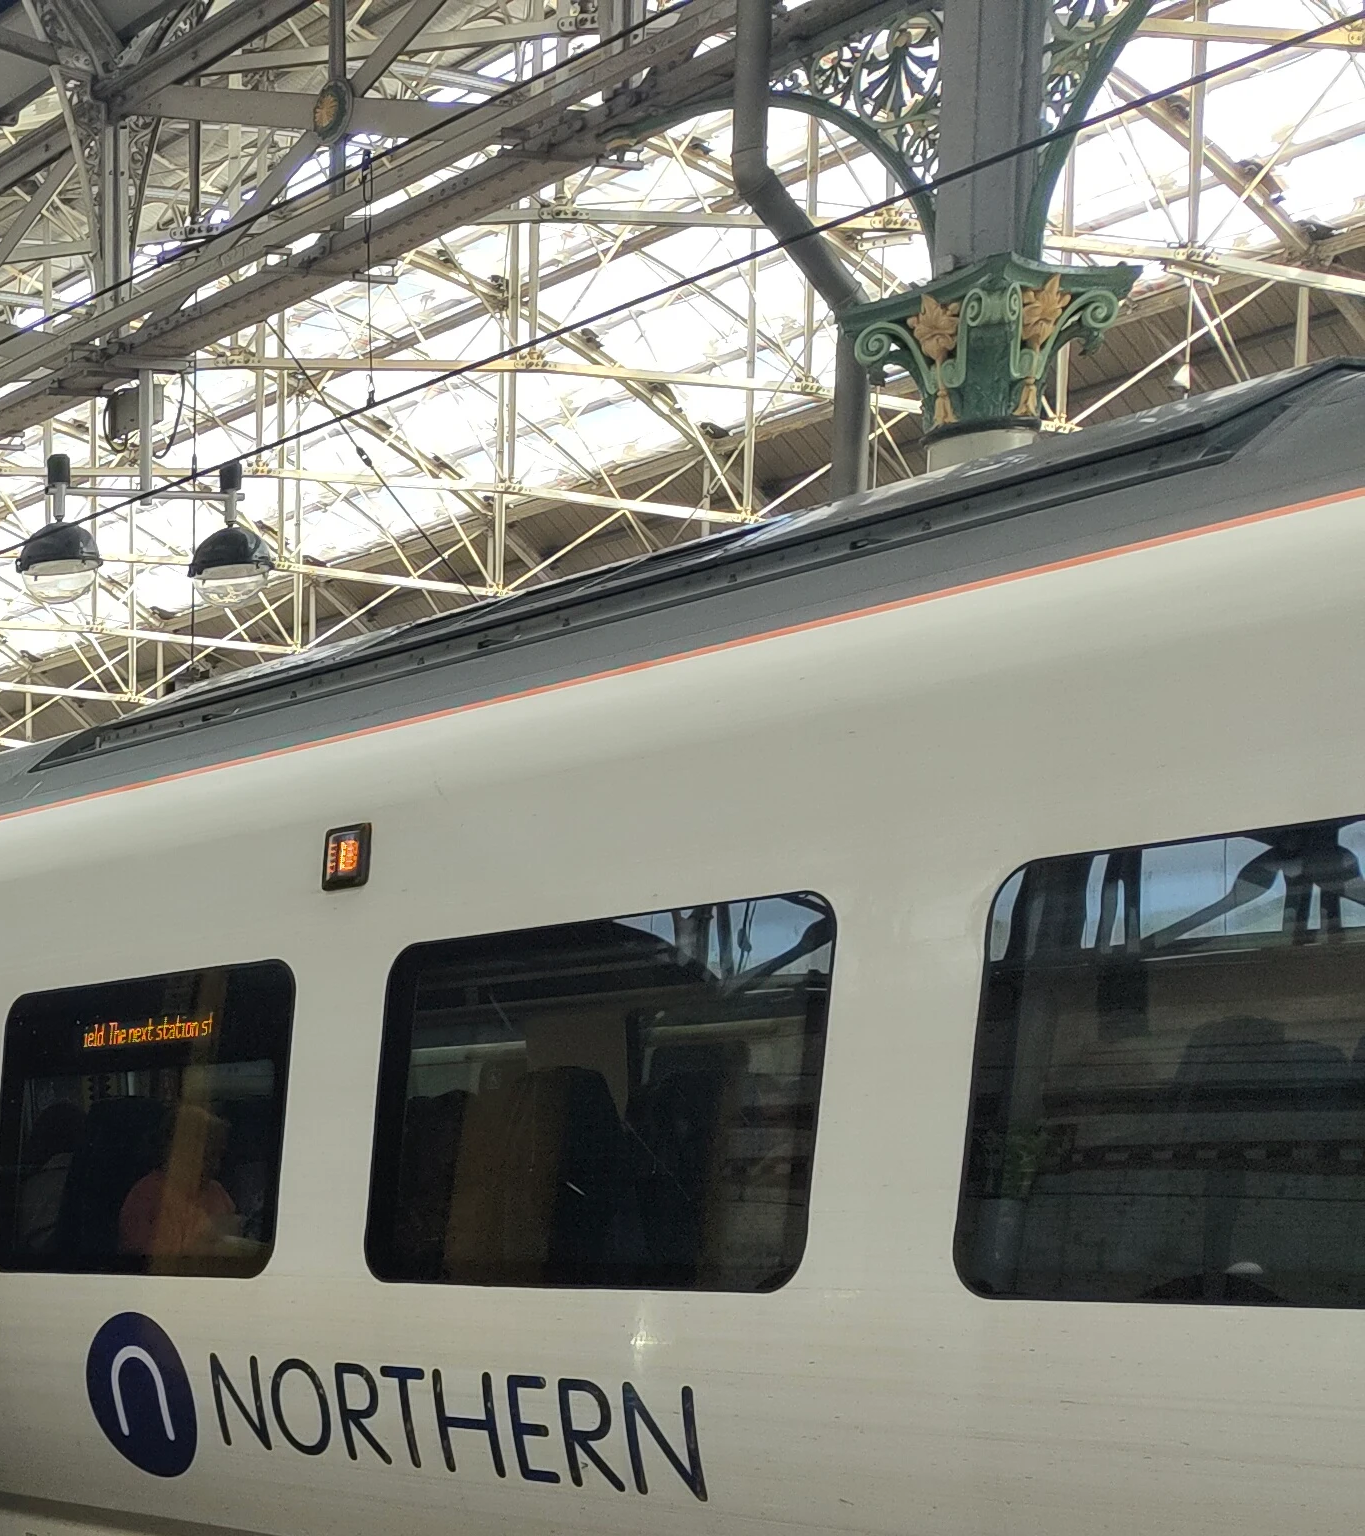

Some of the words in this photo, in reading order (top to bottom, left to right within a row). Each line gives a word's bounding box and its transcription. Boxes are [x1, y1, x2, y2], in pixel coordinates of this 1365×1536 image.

[109, 1021, 127, 1045] The
[128, 1018, 153, 1043] next
[155, 1014, 199, 1041] station
[210, 1352, 709, 1502] NORTHERN
